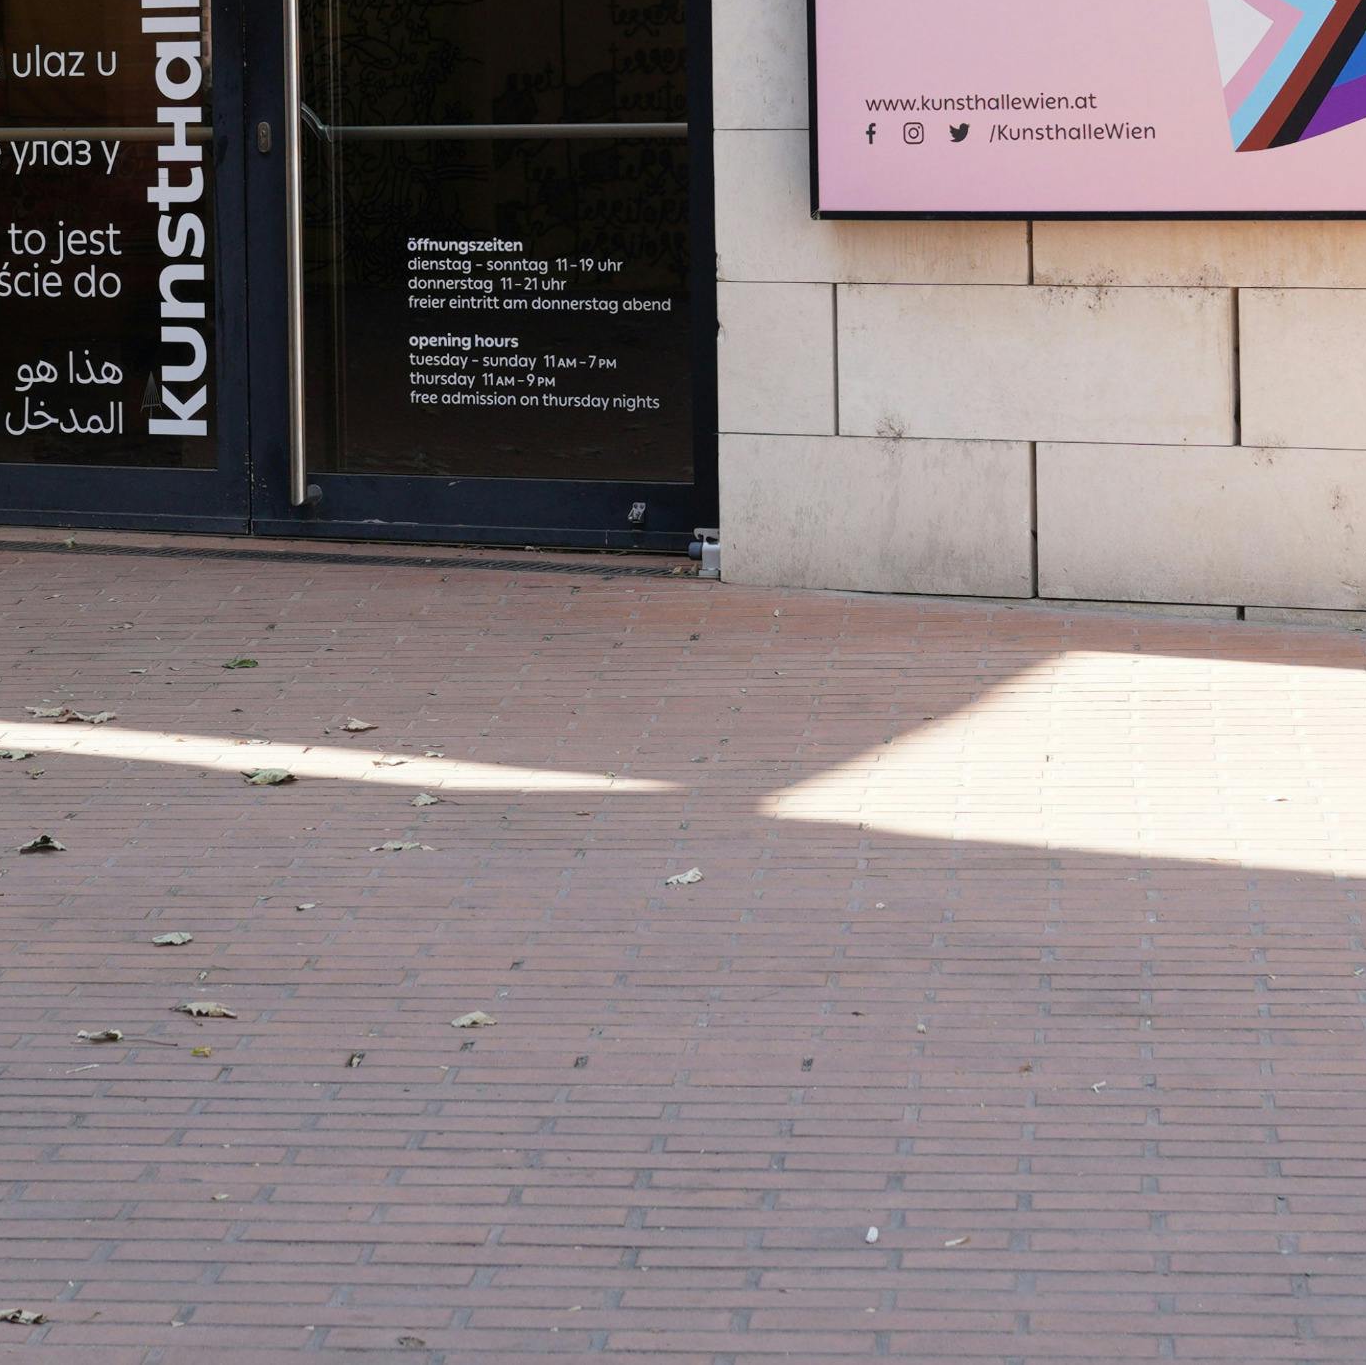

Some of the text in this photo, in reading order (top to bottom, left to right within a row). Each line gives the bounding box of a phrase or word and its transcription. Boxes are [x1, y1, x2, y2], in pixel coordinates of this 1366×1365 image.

[12, 44, 85, 78] ulaz
[97, 51, 117, 77] u
[865, 92, 1098, 112] www.kunsthallewien.at
[989, 121, 1156, 144] /KunsthalleWien
[10, 140, 92, 175] улаз
[100, 140, 121, 175] у
[7, 221, 122, 264] to jest
[406, 236, 524, 256] öffnungszeiten
[407, 256, 472, 275] dienstag
[486, 258, 549, 275] sonntag
[597, 258, 624, 272] uhr
[73, 264, 122, 298] do
[407, 276, 493, 294] donnerstag
[541, 277, 567, 291] uhr
[407, 294, 671, 315] freier eintritt am donnerstag abend
[408, 332, 519, 351] opening hours
[15, 349, 123, 392] هذا هو
[408, 352, 469, 370] tuesday
[482, 354, 537, 371] sunday
[409, 371, 476, 389] thursday
[409, 389, 660, 412] free admission on thursday nights
[5, 396, 123, 436] المدخل
